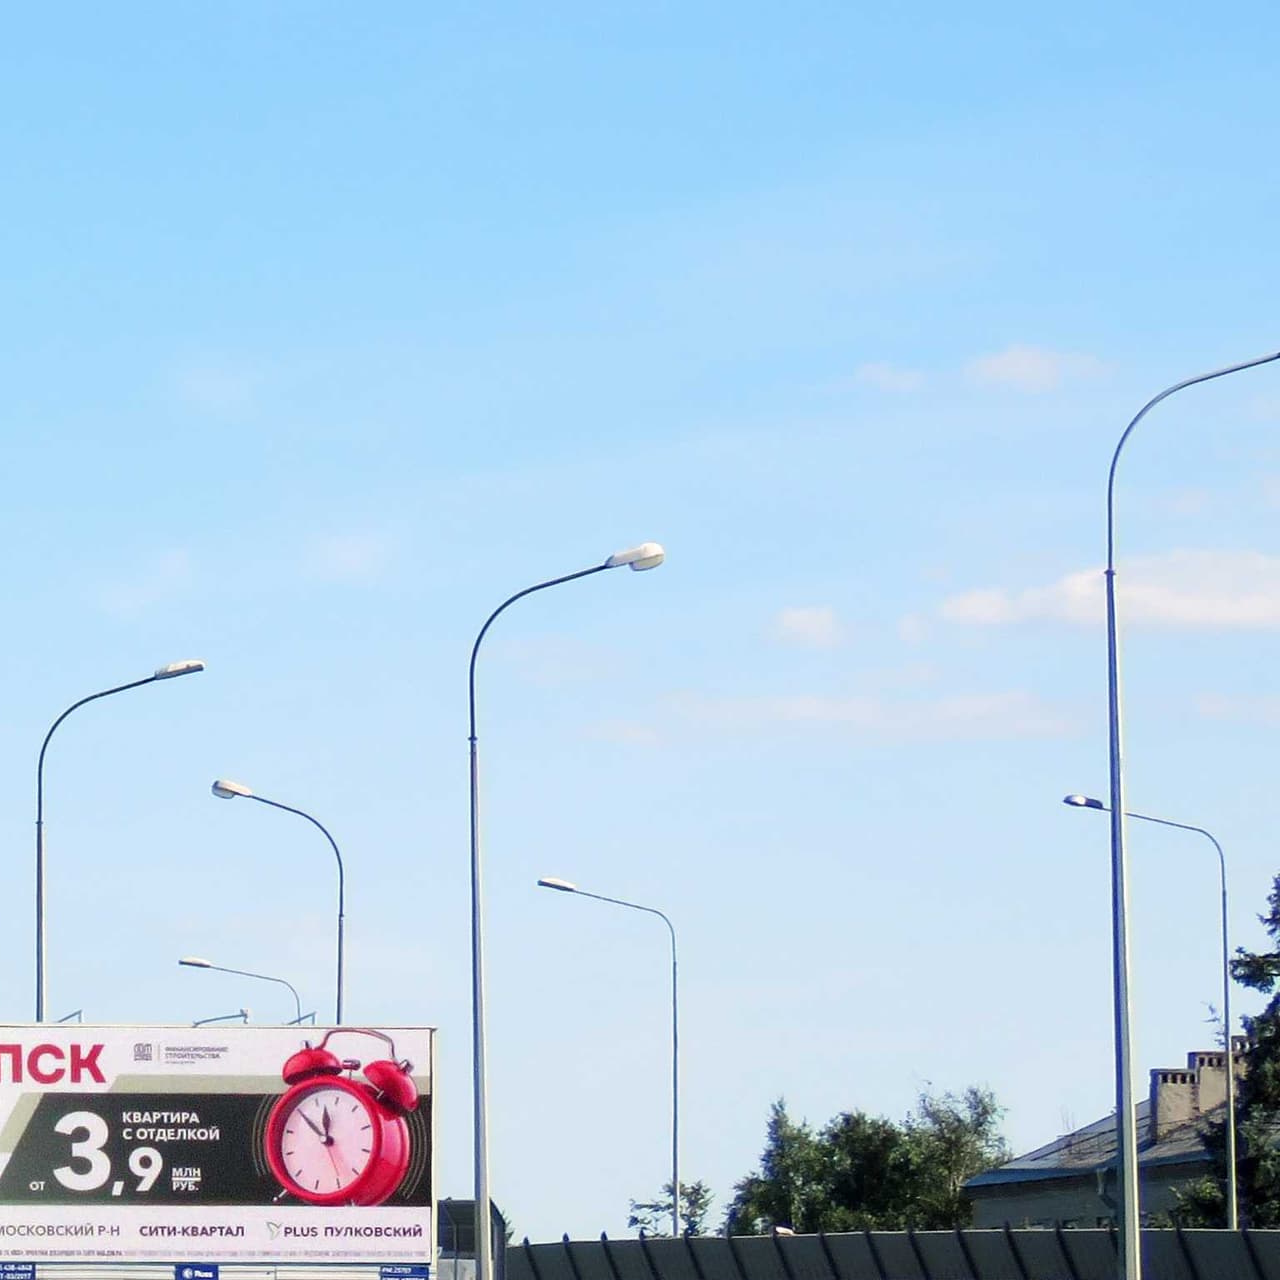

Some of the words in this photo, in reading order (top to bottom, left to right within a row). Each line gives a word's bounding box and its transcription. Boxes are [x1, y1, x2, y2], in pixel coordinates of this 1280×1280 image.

[122, 1112, 200, 1124] КВАРТИРА
[122, 1128, 133, 1141] С
[136, 1126, 221, 1142] ОТДЕЛКОЙ
[172, 1167, 201, 1177] МЛН
[172, 1182, 200, 1192] РУБ.
[97, 1225, 121, 1237] Р-Н
[139, 1225, 245, 1238] СИТИ-КВАРТАЛ
[283, 1226, 319, 1238] PLUS
[324, 1224, 423, 1237] ПУЛКОВСКИЙ
